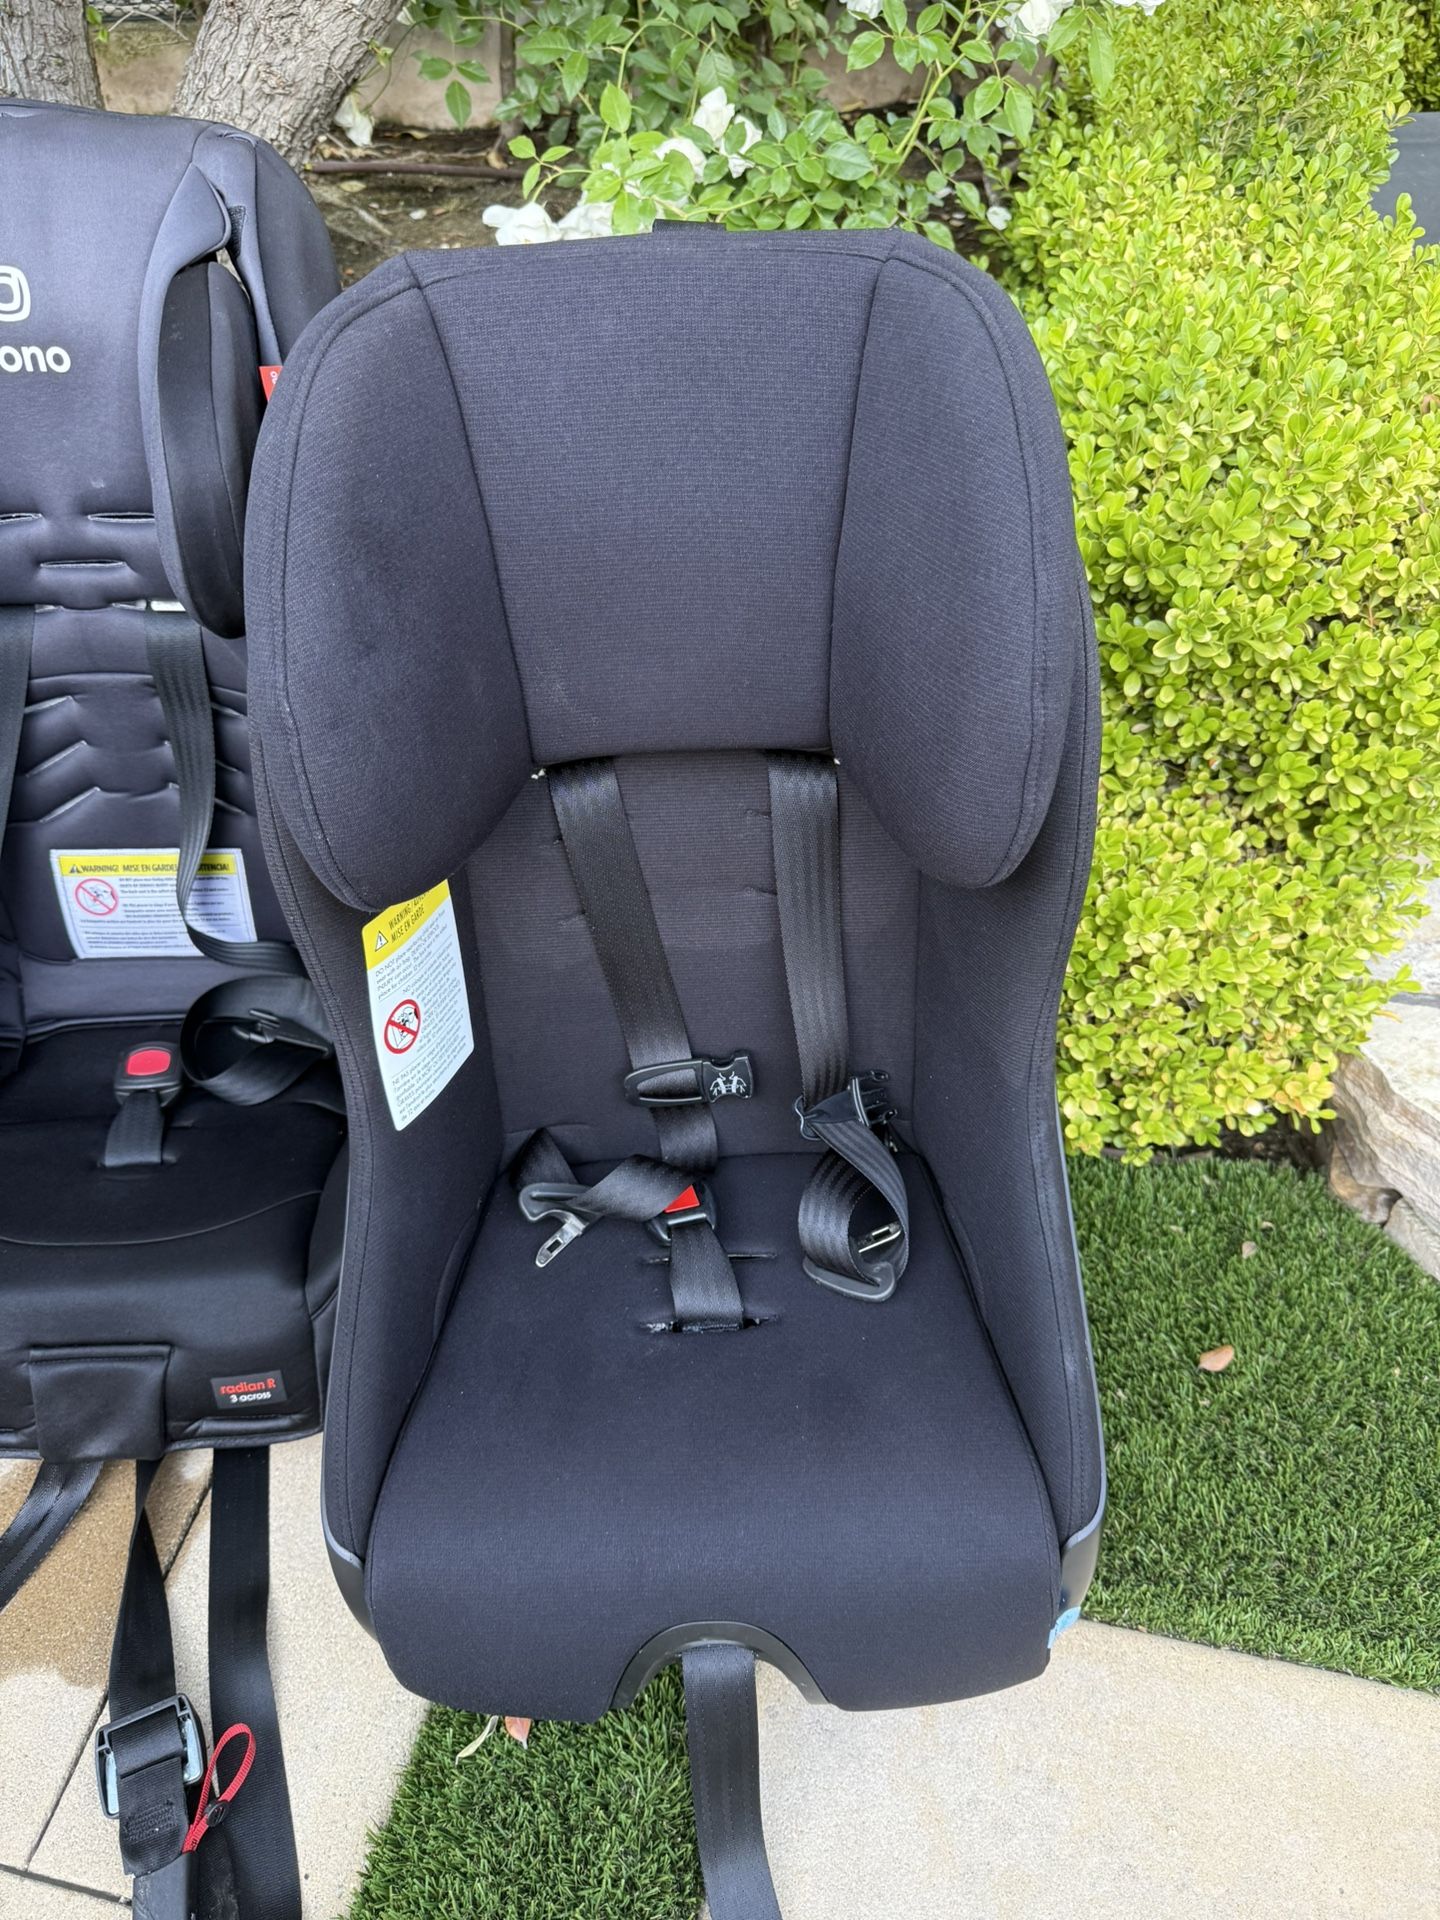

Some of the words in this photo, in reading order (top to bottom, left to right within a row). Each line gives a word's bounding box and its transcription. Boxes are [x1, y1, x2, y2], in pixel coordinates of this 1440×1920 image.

[0, 345, 71, 373] ono
[389, 903, 411, 930] WARNING
[391, 925, 403, 943] MISE
[404, 918, 411, 931] EN
[410, 903, 424, 926] GARDE
[219, 1381, 265, 1395] radian
[267, 1378, 276, 1389] R
[229, 1394, 238, 1403] 3
[238, 1391, 272, 1402] across
